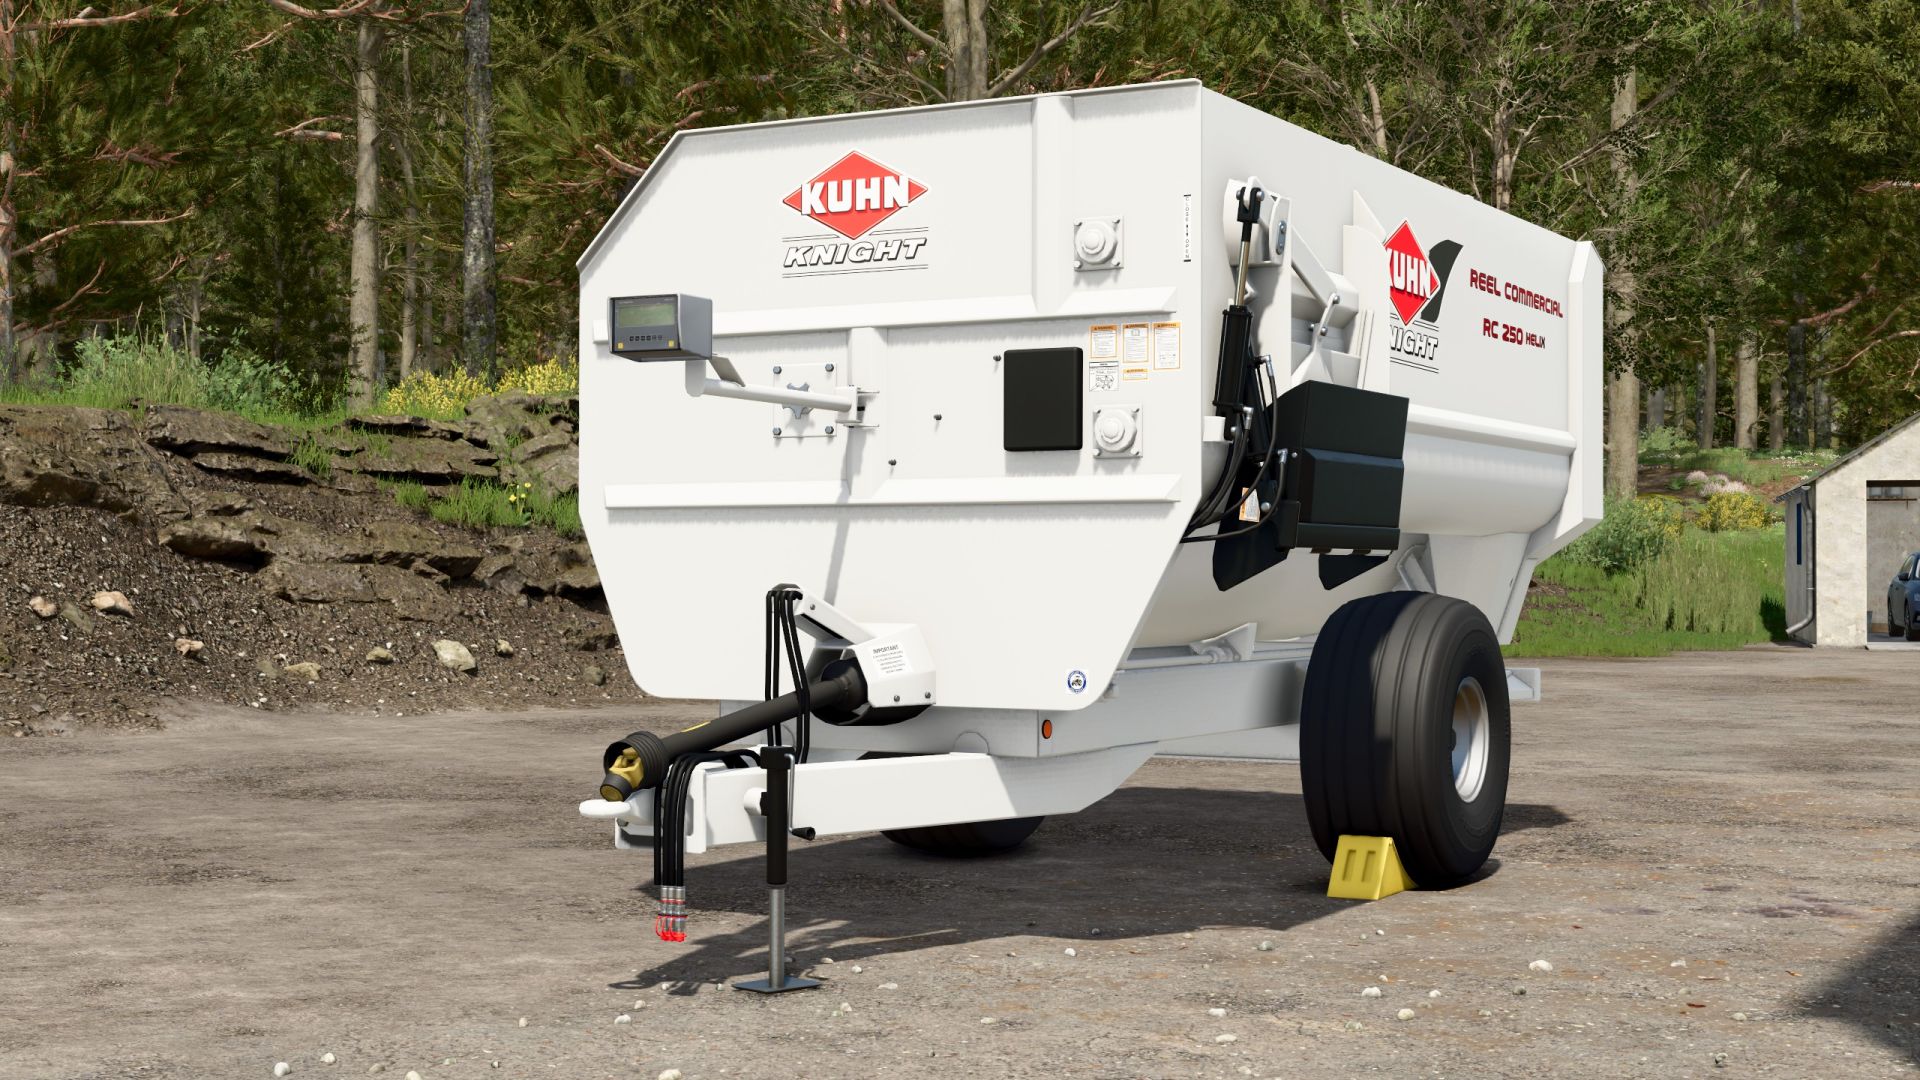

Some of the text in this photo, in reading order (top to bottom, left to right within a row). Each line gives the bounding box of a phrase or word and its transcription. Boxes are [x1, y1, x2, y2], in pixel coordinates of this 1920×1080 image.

[801, 174, 909, 216] KUHN
[783, 237, 928, 268] KNIGHT
[1469, 267, 1564, 318] REEL COMMERCIAL
[1483, 317, 1546, 349] RC 250 HELIX
[872, 644, 899, 655] IMPORTANT
